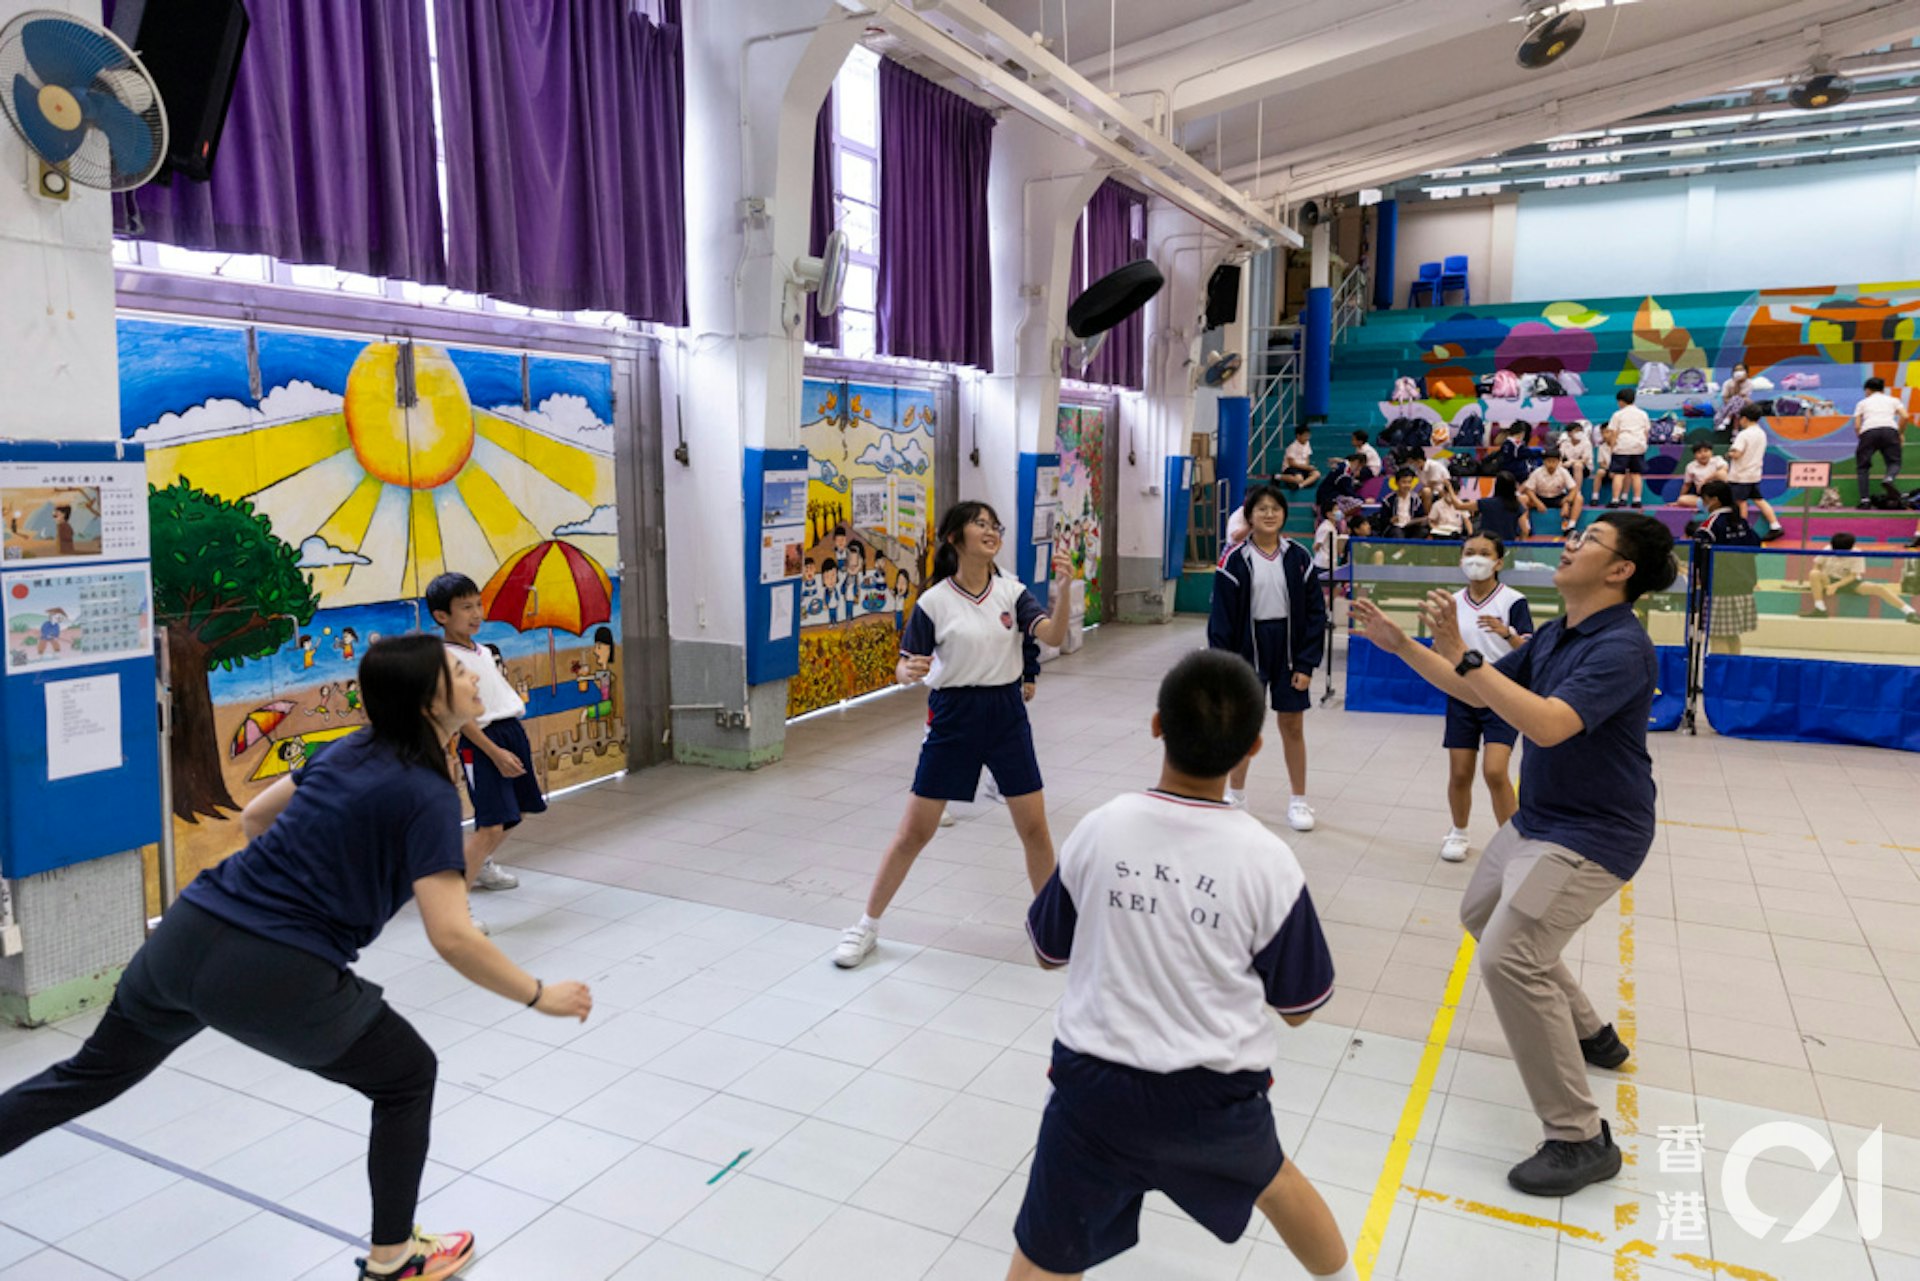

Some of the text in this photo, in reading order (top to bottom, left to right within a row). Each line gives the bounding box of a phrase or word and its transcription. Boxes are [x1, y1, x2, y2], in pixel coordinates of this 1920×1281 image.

[1115, 861, 1216, 899] S. K. H.
[1109, 890, 1220, 929] KEI OI
